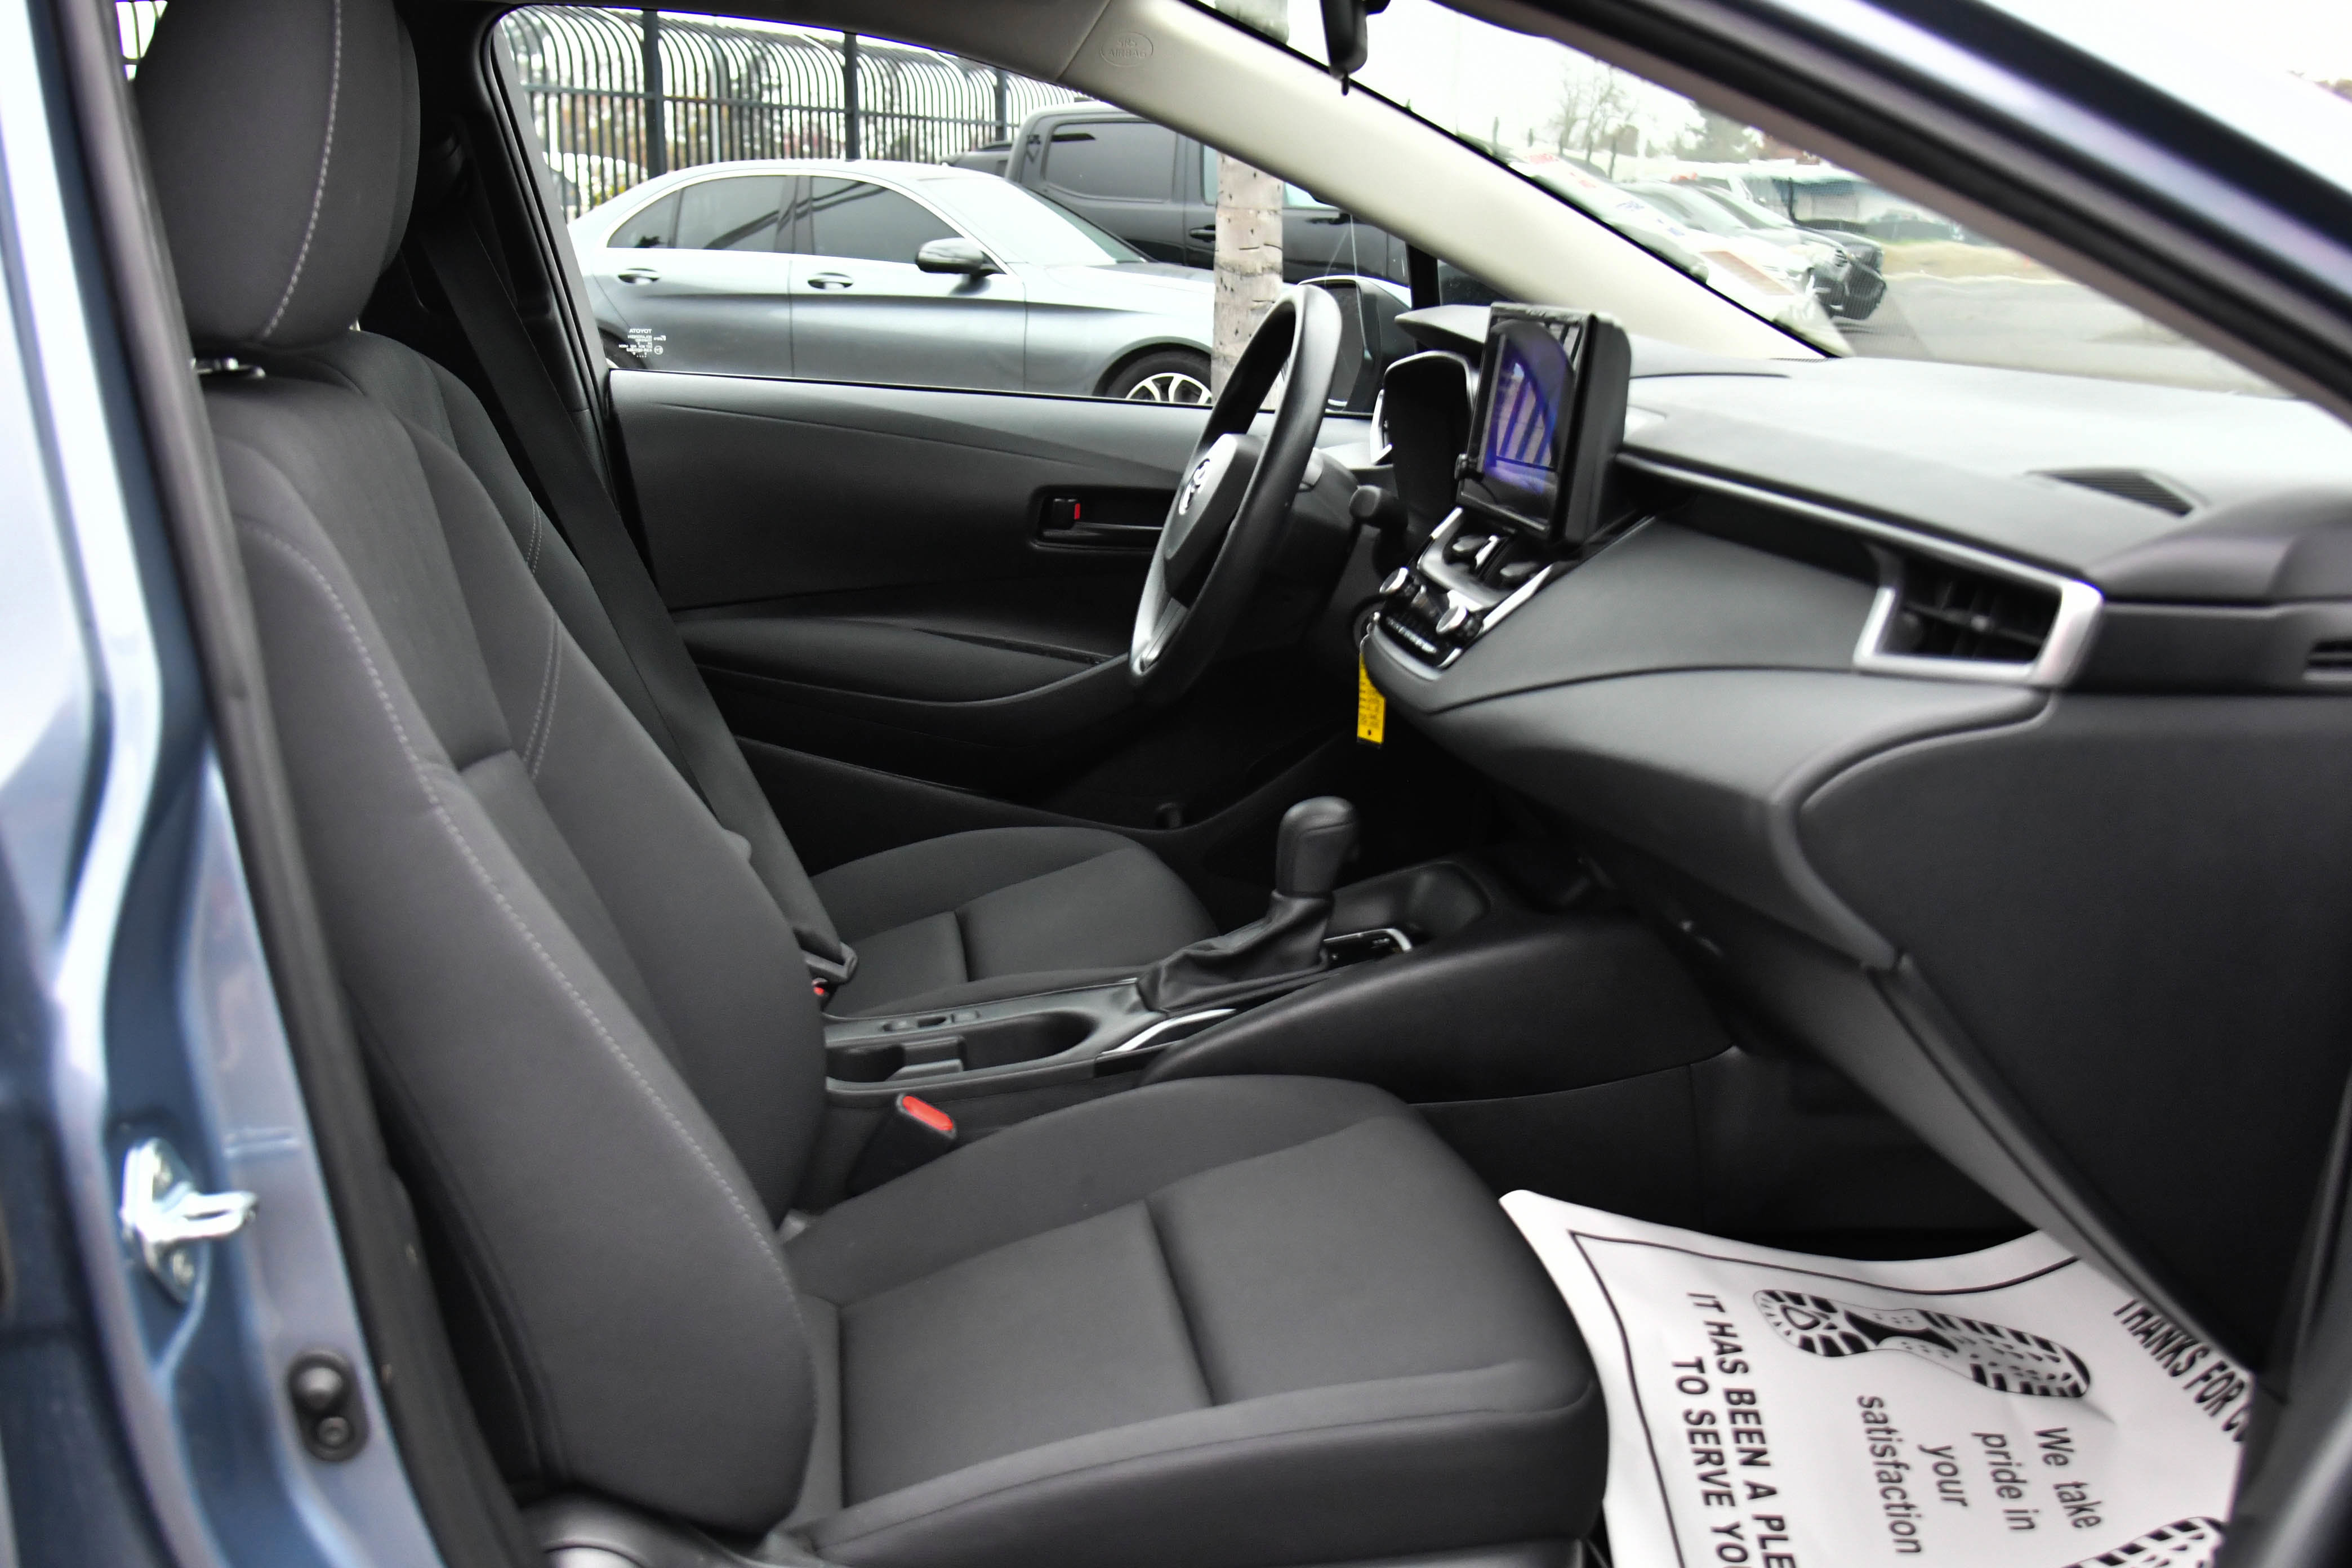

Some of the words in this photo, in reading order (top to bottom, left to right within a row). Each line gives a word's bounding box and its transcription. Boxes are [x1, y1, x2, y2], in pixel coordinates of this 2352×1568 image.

[1686, 1292, 1725, 1313] IT
[1703, 1320, 1749, 1374] HAS
[1671, 1356, 1709, 1395] TO
[2182, 1360, 2246, 1418] FOR
[1723, 1387, 1771, 1467] BEEN
[2034, 1427, 2074, 1467] We
[1682, 1408, 1736, 1507] SERVE
[1856, 1395, 1923, 1554] satisfaction
[1917, 1444, 1968, 1508] your
[1972, 1431, 2028, 1500] pride
[2003, 1508, 2040, 1531] in
[1743, 1479, 1778, 1500] A
[2053, 1481, 2102, 1529] take
